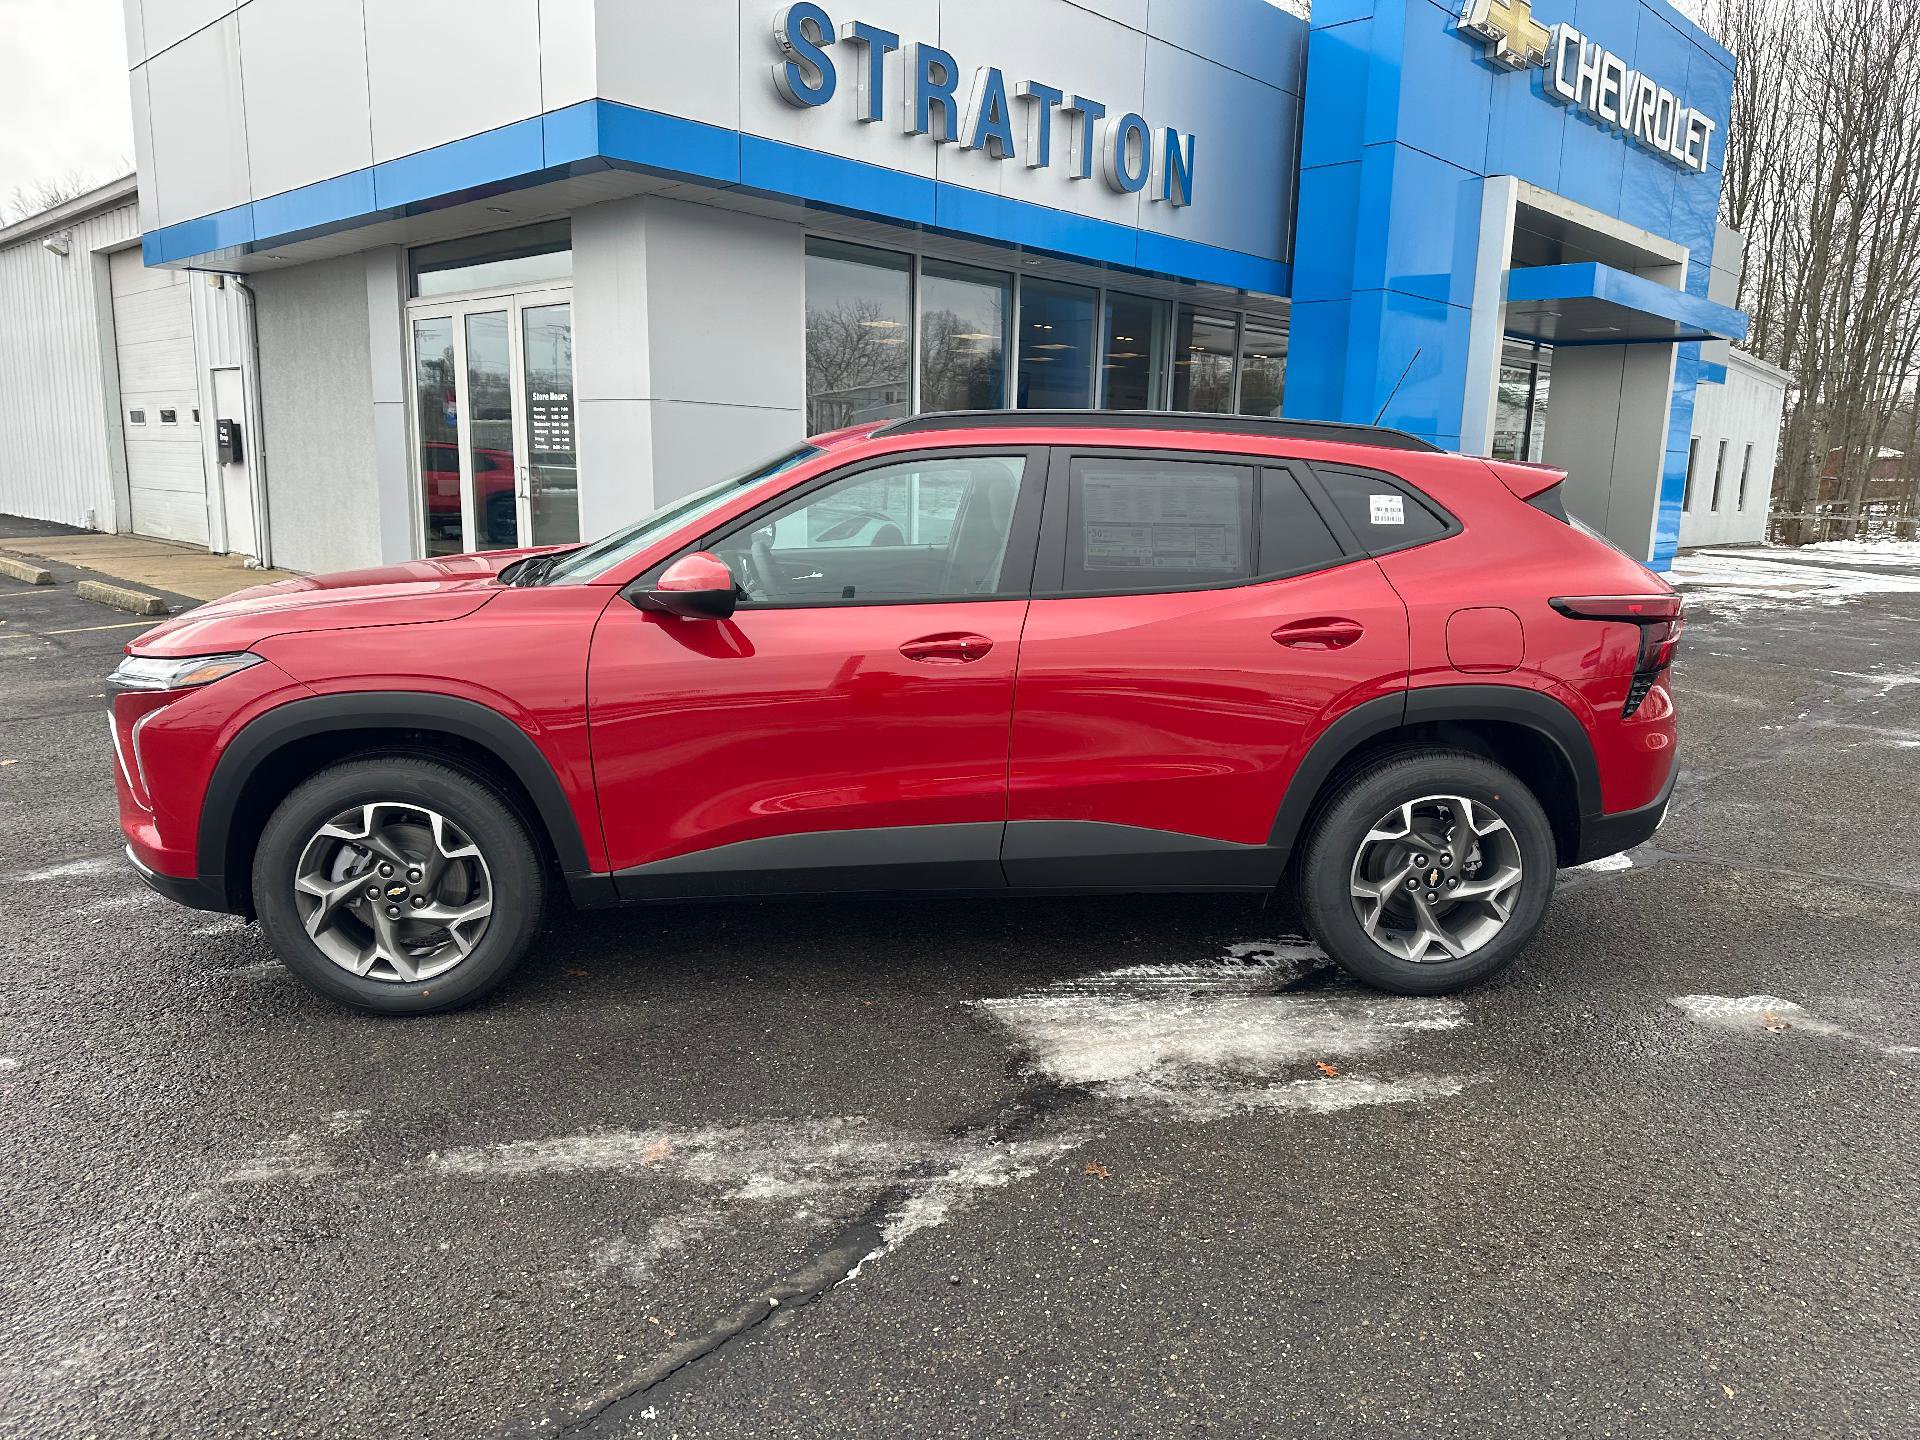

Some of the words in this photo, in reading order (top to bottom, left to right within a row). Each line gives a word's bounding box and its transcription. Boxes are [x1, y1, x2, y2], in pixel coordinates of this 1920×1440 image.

[773, 2, 1196, 207] STRATTON
[1547, 22, 1716, 174] CHEVROLET
[533, 392, 549, 400] Store
[550, 392, 568, 400] Hours
